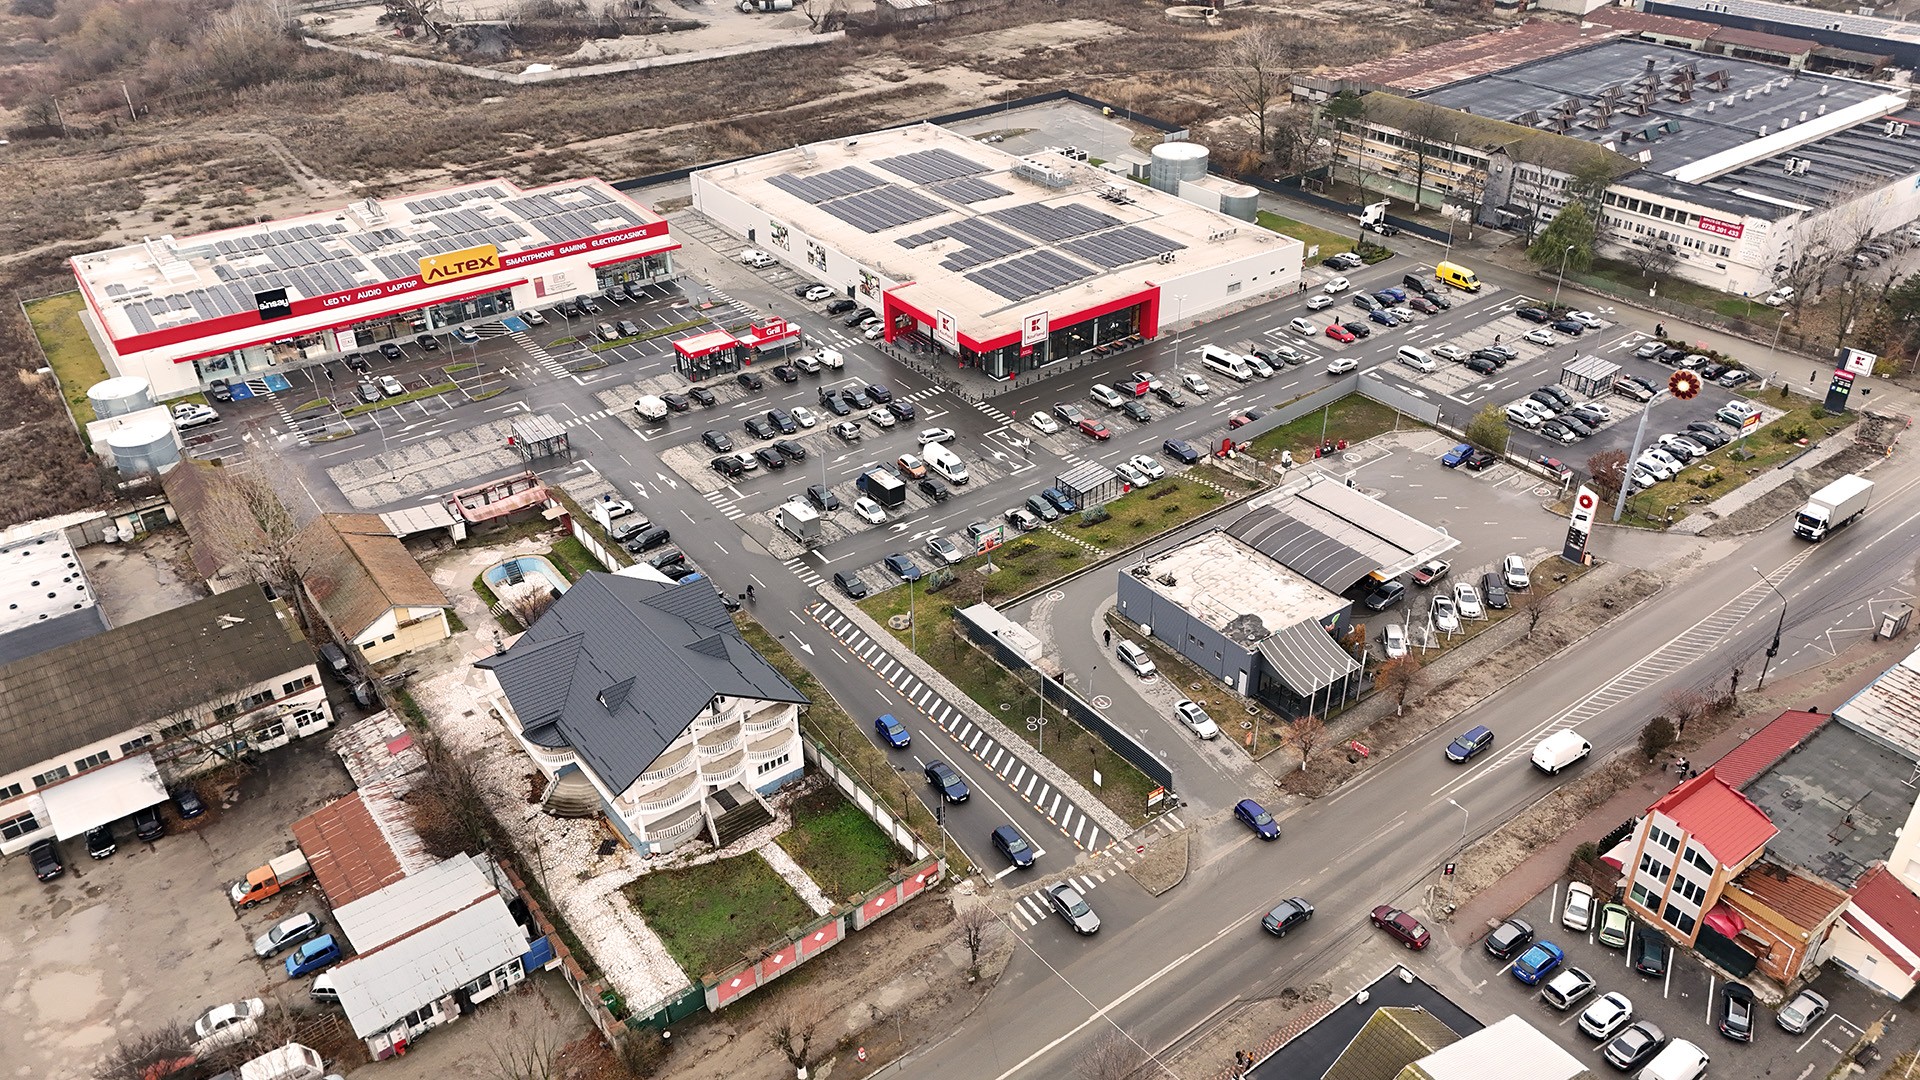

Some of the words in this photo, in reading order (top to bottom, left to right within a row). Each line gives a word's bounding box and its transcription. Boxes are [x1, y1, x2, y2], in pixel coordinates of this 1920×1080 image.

[505, 250, 555, 266] SMARTPHONE
[559, 243, 587, 255] GAMING
[591, 229, 647, 247] ELECTROCASNICE
[323, 299, 340, 307] LED
[340, 295, 350, 303] TV
[357, 288, 382, 300] AUDIO
[387, 280, 418, 293] LAPTOP
[259, 298, 289, 311] sinsay
[766, 327, 780, 336] Grill
